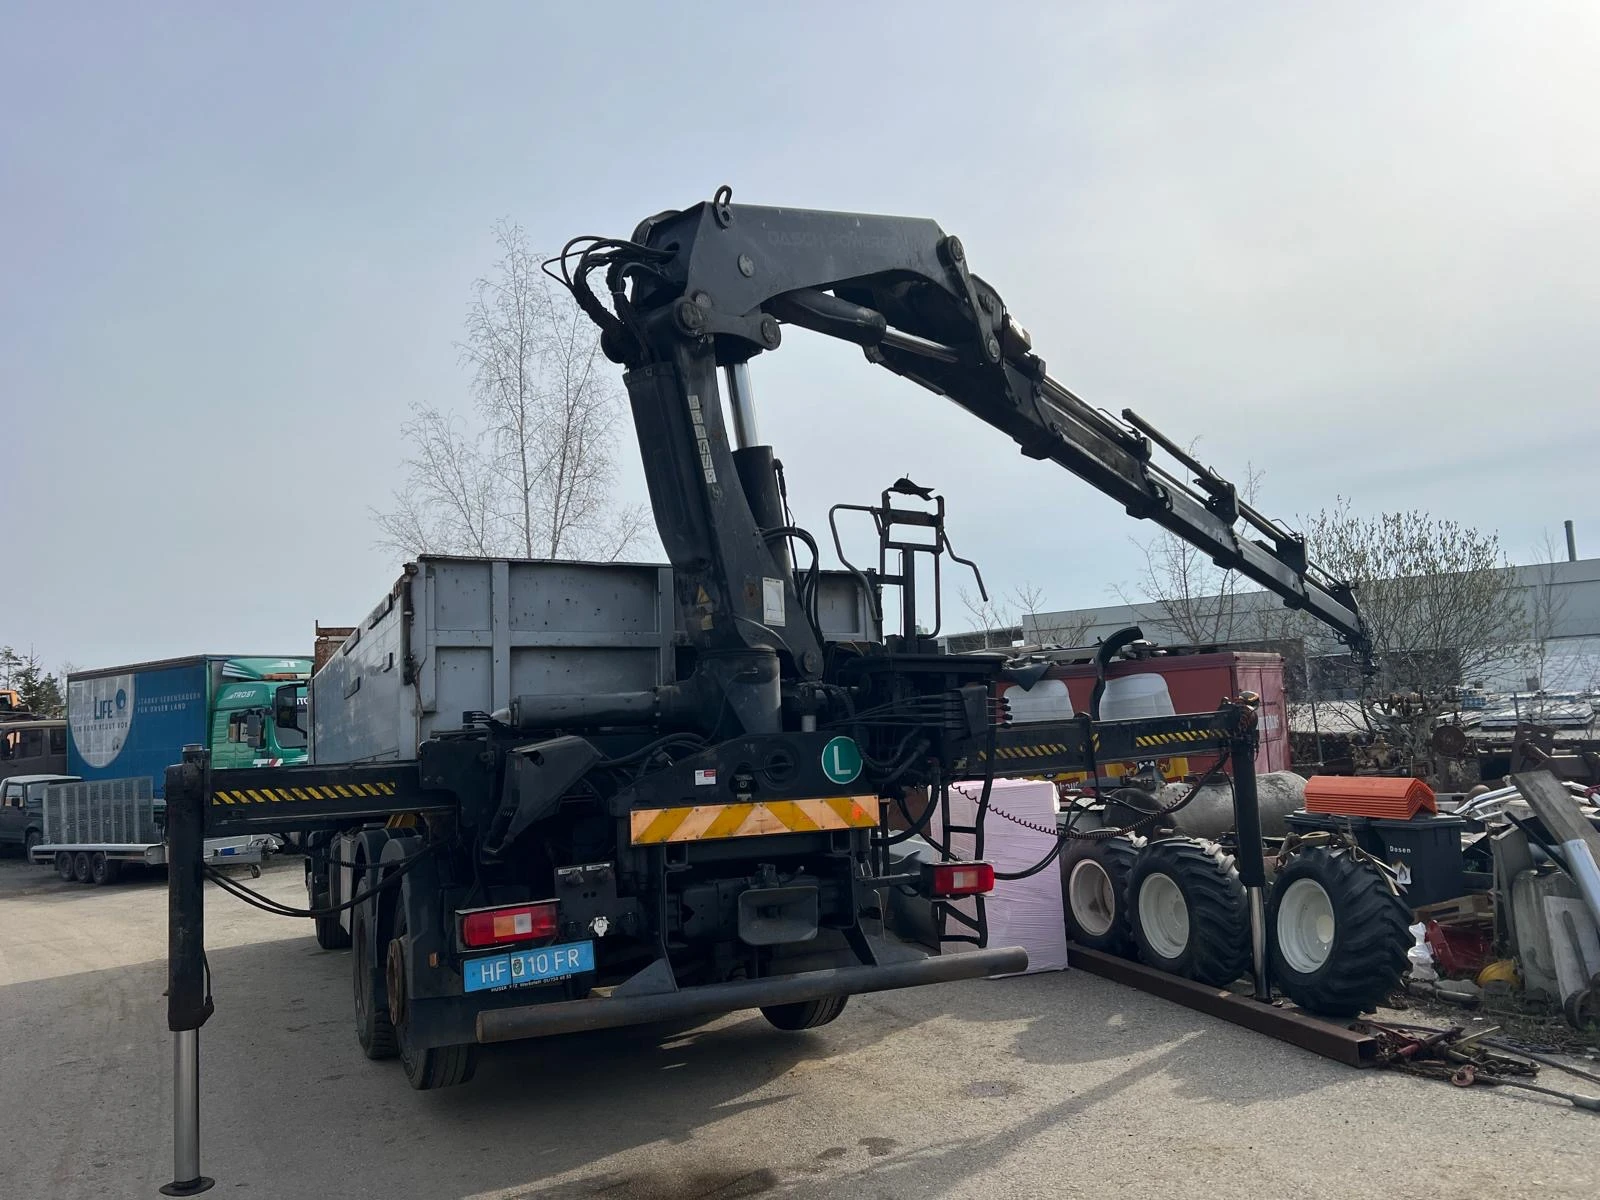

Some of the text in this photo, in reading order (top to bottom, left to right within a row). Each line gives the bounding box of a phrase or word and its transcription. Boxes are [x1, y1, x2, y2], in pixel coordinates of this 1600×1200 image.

[170, 702, 186, 712] LAND
[833, 745, 852, 775] L
[1389, 845, 1412, 854] Dosen
[481, 948, 580, 984] HF 10 FR
